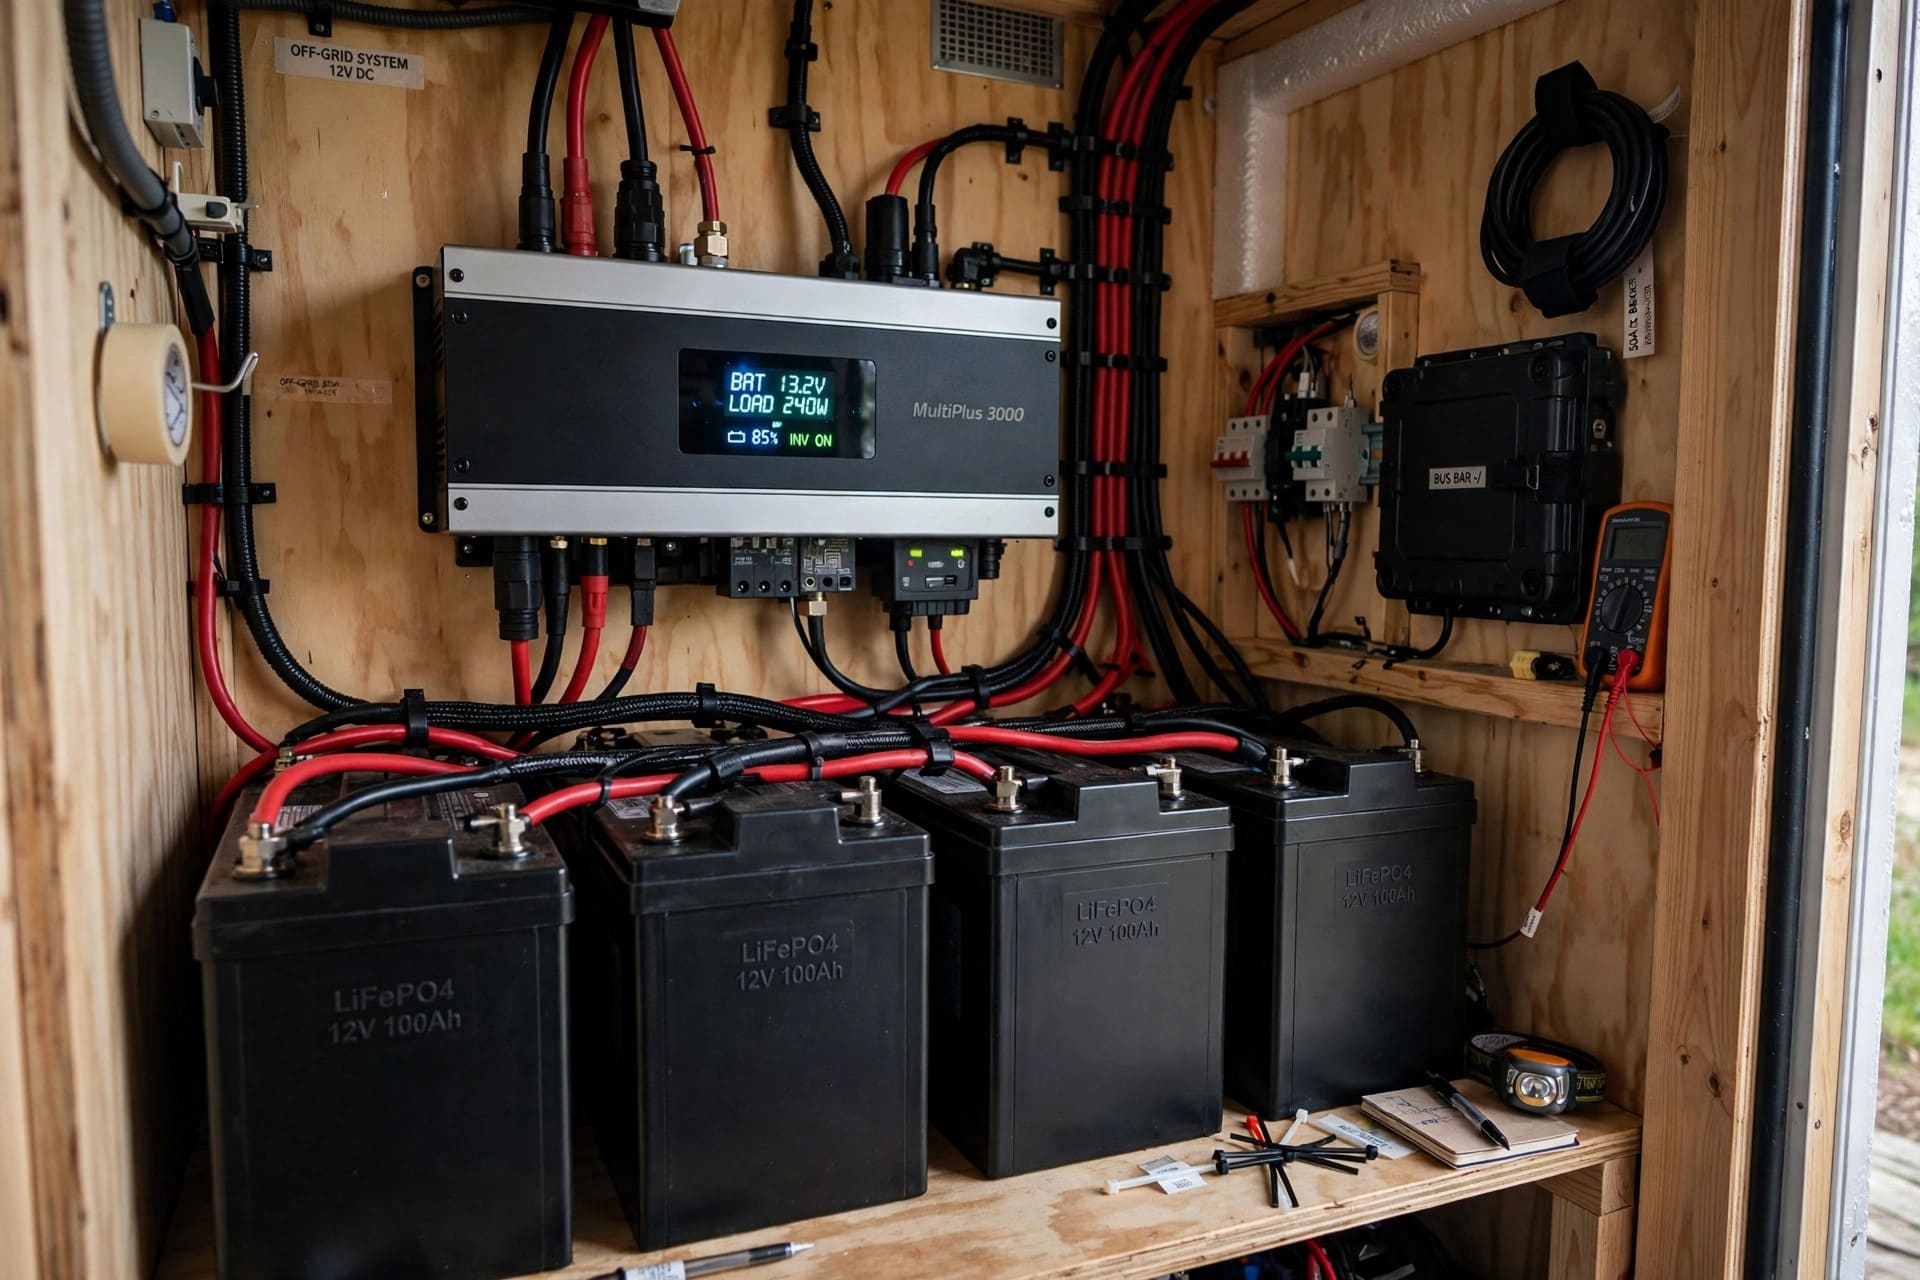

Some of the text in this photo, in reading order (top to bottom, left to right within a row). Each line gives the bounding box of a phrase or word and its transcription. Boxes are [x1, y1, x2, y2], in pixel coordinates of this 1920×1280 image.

[290, 44, 408, 70] OFF-GRID SYSTEM
[329, 65, 374, 81] 12V DC
[730, 372, 826, 394] BAT 13.2V
[729, 394, 829, 416] LOAD 240W
[913, 402, 1025, 422] MultiPlus 3000
[752, 429, 832, 447] 85% INV ON
[1433, 472, 1451, 485] BUS
[1453, 471, 1472, 484] BAR
[1346, 863, 1412, 888] LiFePO4
[1077, 895, 1157, 921] LiFePO4
[1342, 886, 1416, 910] 12V 100Ah
[1072, 919, 1159, 946] 12V 100Ah
[742, 933, 839, 962] LiFePO4
[737, 960, 843, 991] 12V 100Ah
[334, 978, 455, 1012] LiFePO4
[328, 1009, 462, 1044] 12V 100Ah
